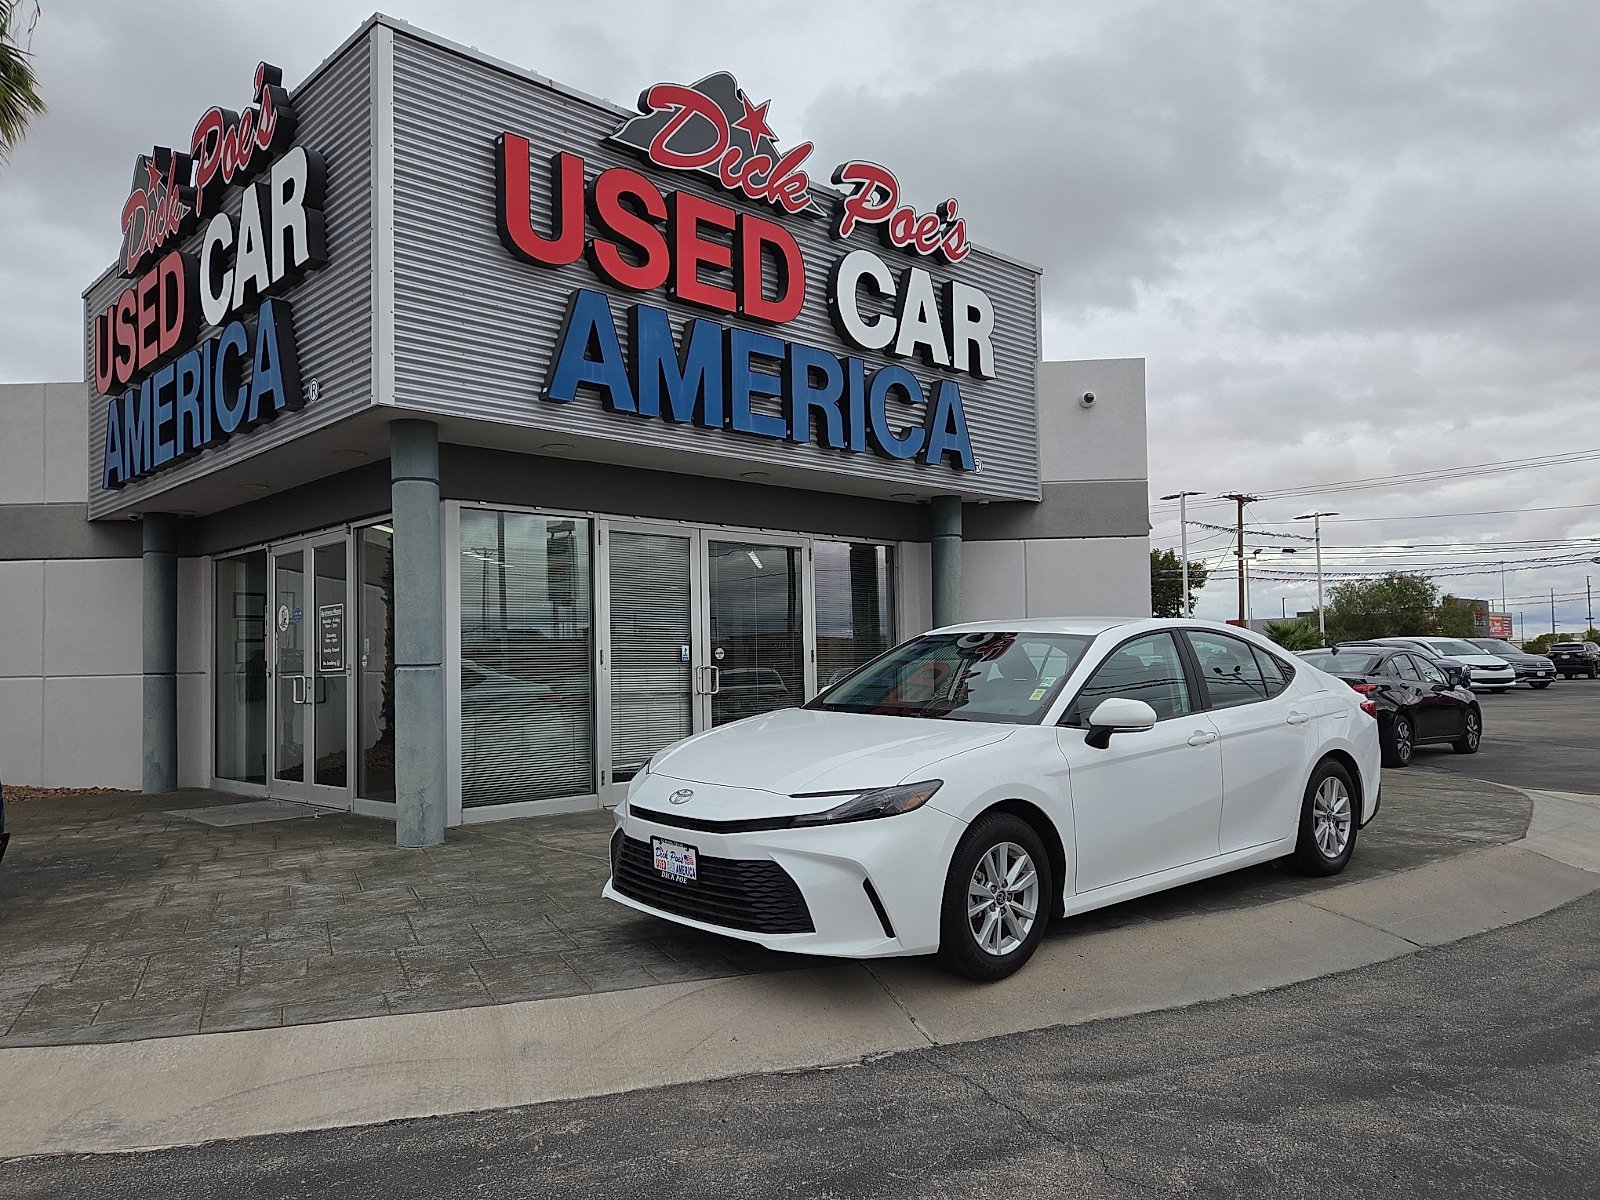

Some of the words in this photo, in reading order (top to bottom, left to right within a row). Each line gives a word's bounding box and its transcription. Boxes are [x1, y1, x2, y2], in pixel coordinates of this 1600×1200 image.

[121, 152, 184, 273] Dick
[191, 61, 279, 216] Poe's
[500, 131, 806, 324] USED
[835, 249, 998, 379] CAR
[646, 83, 813, 213] Dick
[836, 160, 971, 263] Poe's
[95, 250, 185, 395] USED
[200, 146, 309, 326] CAR
[103, 298, 286, 488] AMERICA
[543, 288, 976, 471] AMERICA
[656, 847, 668, 859] Dick
[661, 871, 675, 880] DICK
[676, 876, 687, 884] POE
[676, 864, 695, 878] AMERICA
